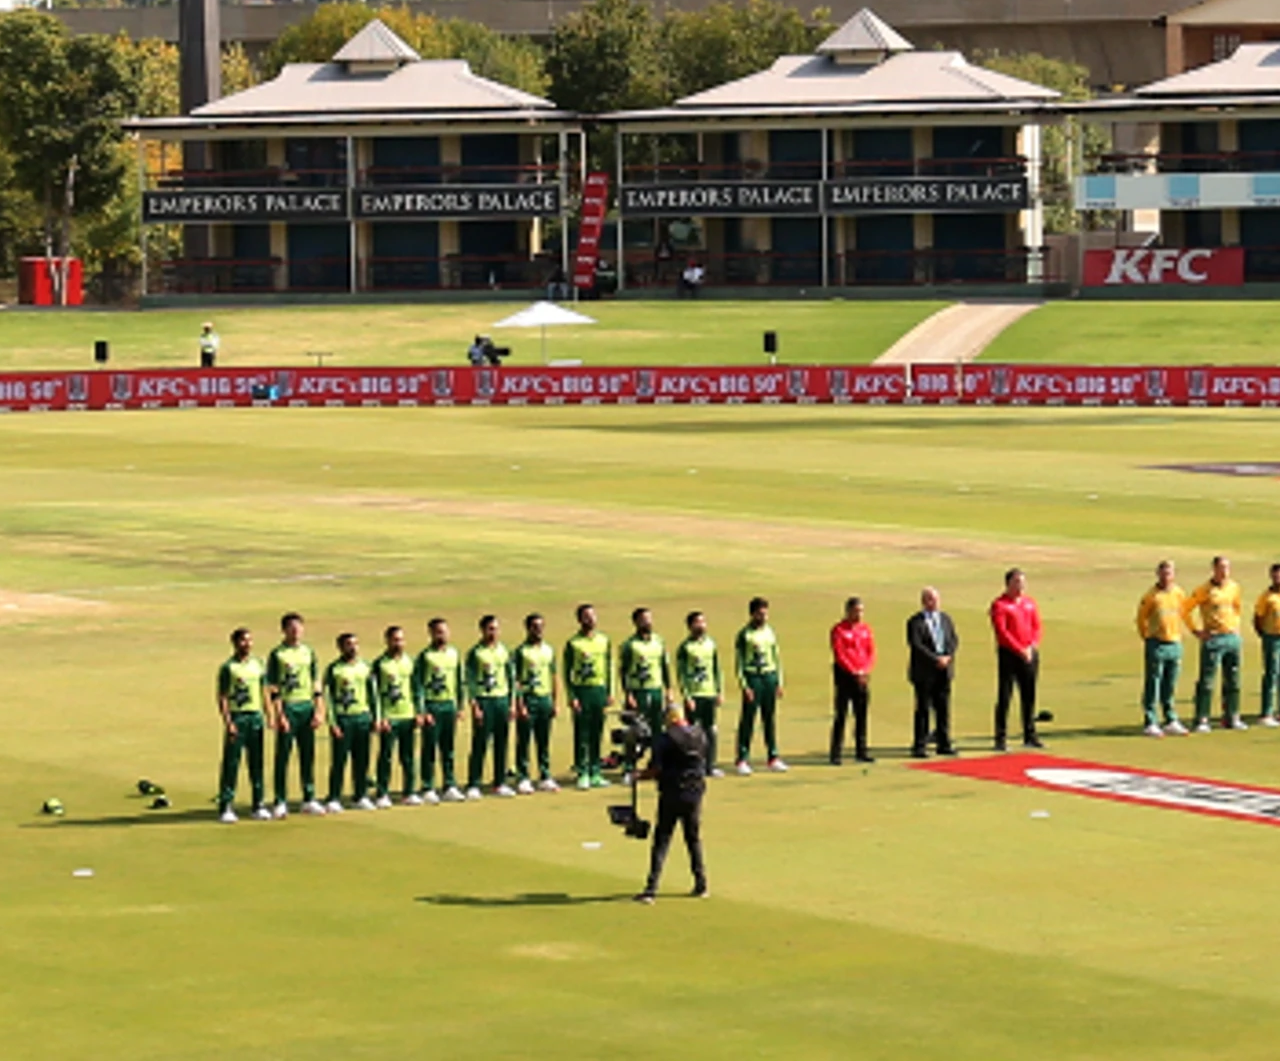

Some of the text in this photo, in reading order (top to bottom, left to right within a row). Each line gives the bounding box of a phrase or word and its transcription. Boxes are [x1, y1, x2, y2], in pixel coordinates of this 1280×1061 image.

[361, 191, 554, 213] EMPERORS PALACE
[627, 186, 812, 207] EMPERORS PALACE
[832, 182, 1022, 203] EMPERORS PALACE
[148, 193, 341, 214] EMPERORS PALACE
[1104, 249, 1212, 284] KFC
